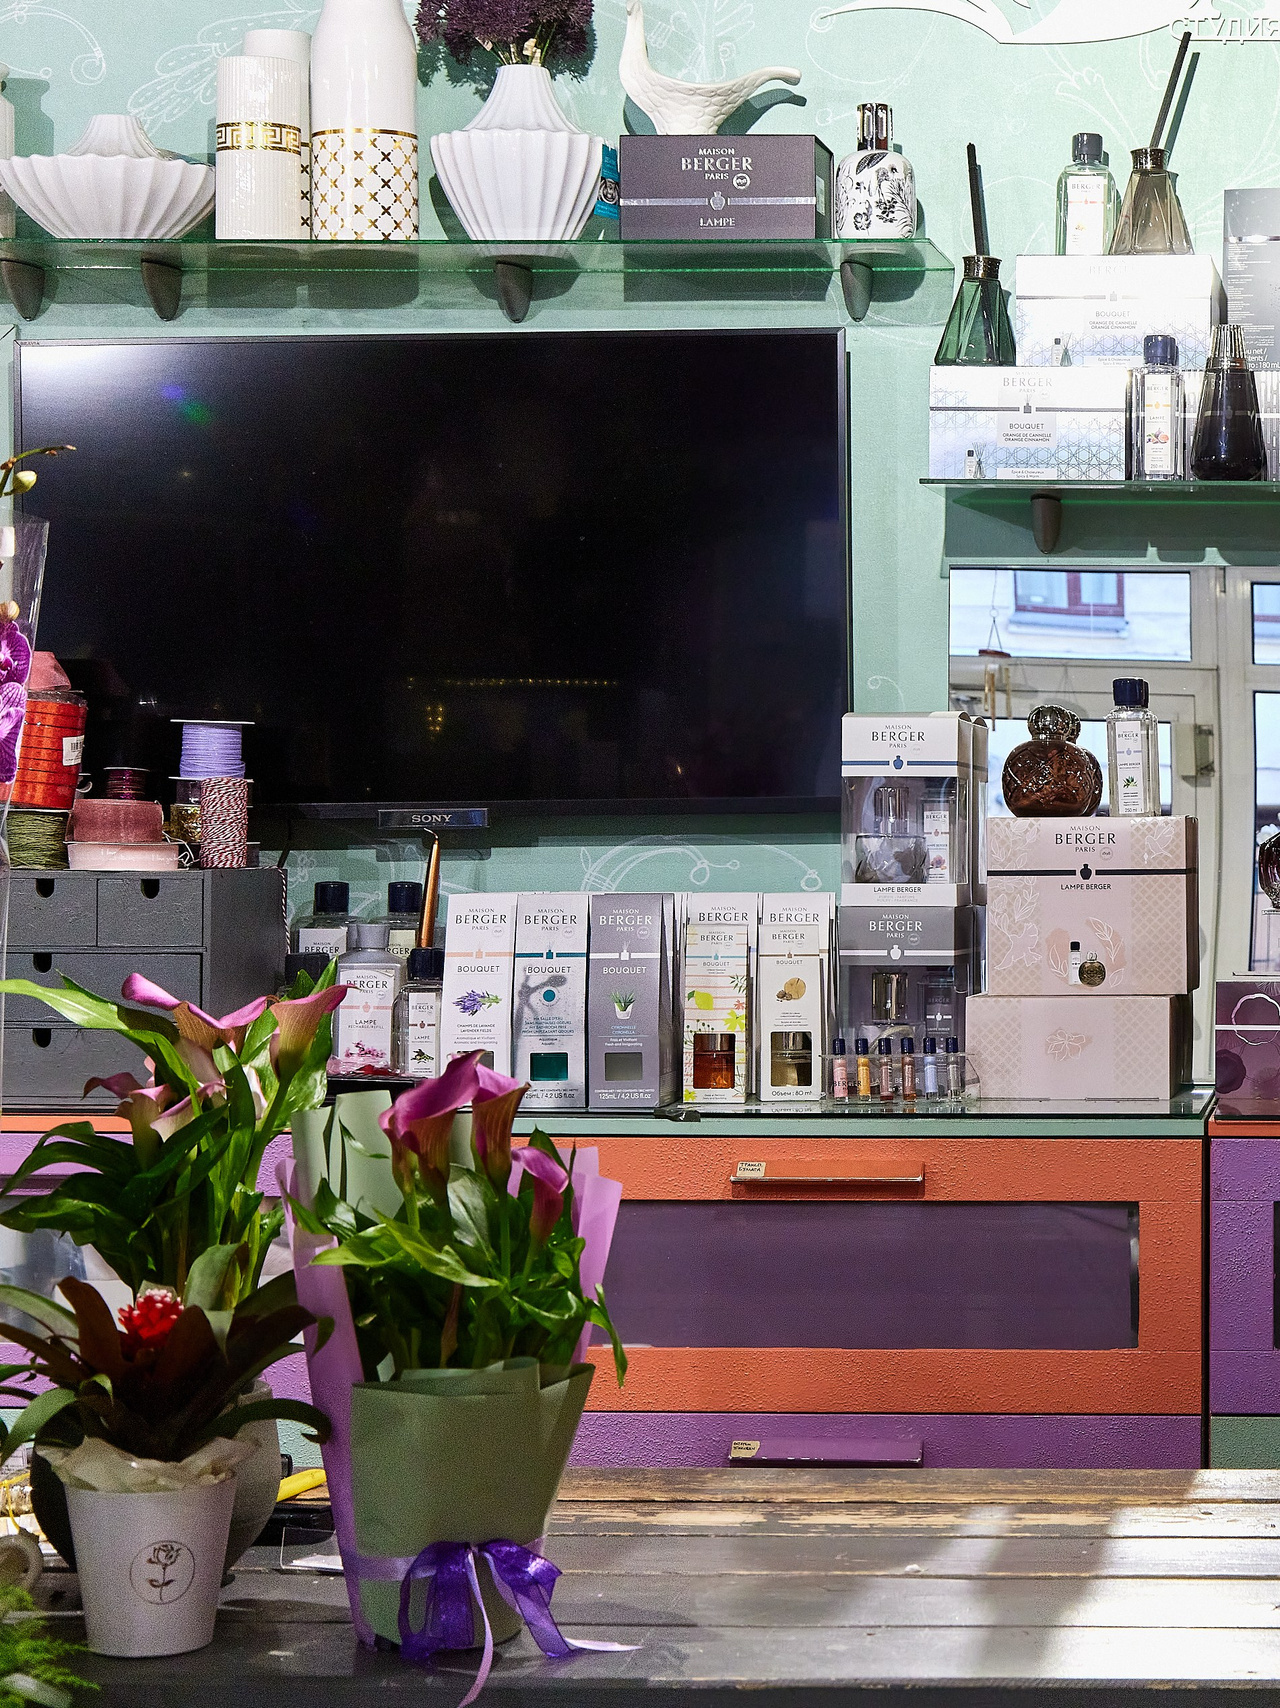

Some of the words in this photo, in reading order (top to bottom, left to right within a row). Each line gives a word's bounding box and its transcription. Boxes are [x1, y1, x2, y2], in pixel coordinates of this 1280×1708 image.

[1171, 17, 1280, 45] СТУДИЯ
[698, 147, 735, 156] MAISON
[681, 156, 753, 171] BERGER
[704, 172, 730, 181] PARIS
[699, 217, 736, 227] LAMPE
[1095, 310, 1130, 318] BOUQUET
[1003, 377, 1053, 387] BERGER
[871, 731, 925, 742] BERGER
[411, 814, 453, 823] SONY
[1055, 833, 1116, 845] BERGER
[455, 914, 507, 924] BERGER
[524, 915, 577, 925] BERGER
[599, 915, 652, 925] BERGER
[698, 912, 749, 922] BERGER
[769, 913, 820, 923] BERGER
[869, 920, 923, 931] BERGER
[700, 934, 734, 942] BERGER
[304, 946, 340, 954] BERGER
[457, 965, 500, 973] BOUQUET
[527, 966, 571, 974] BOUQUET
[603, 966, 647, 974] BOUQUET
[346, 980, 388, 989] BERGER
